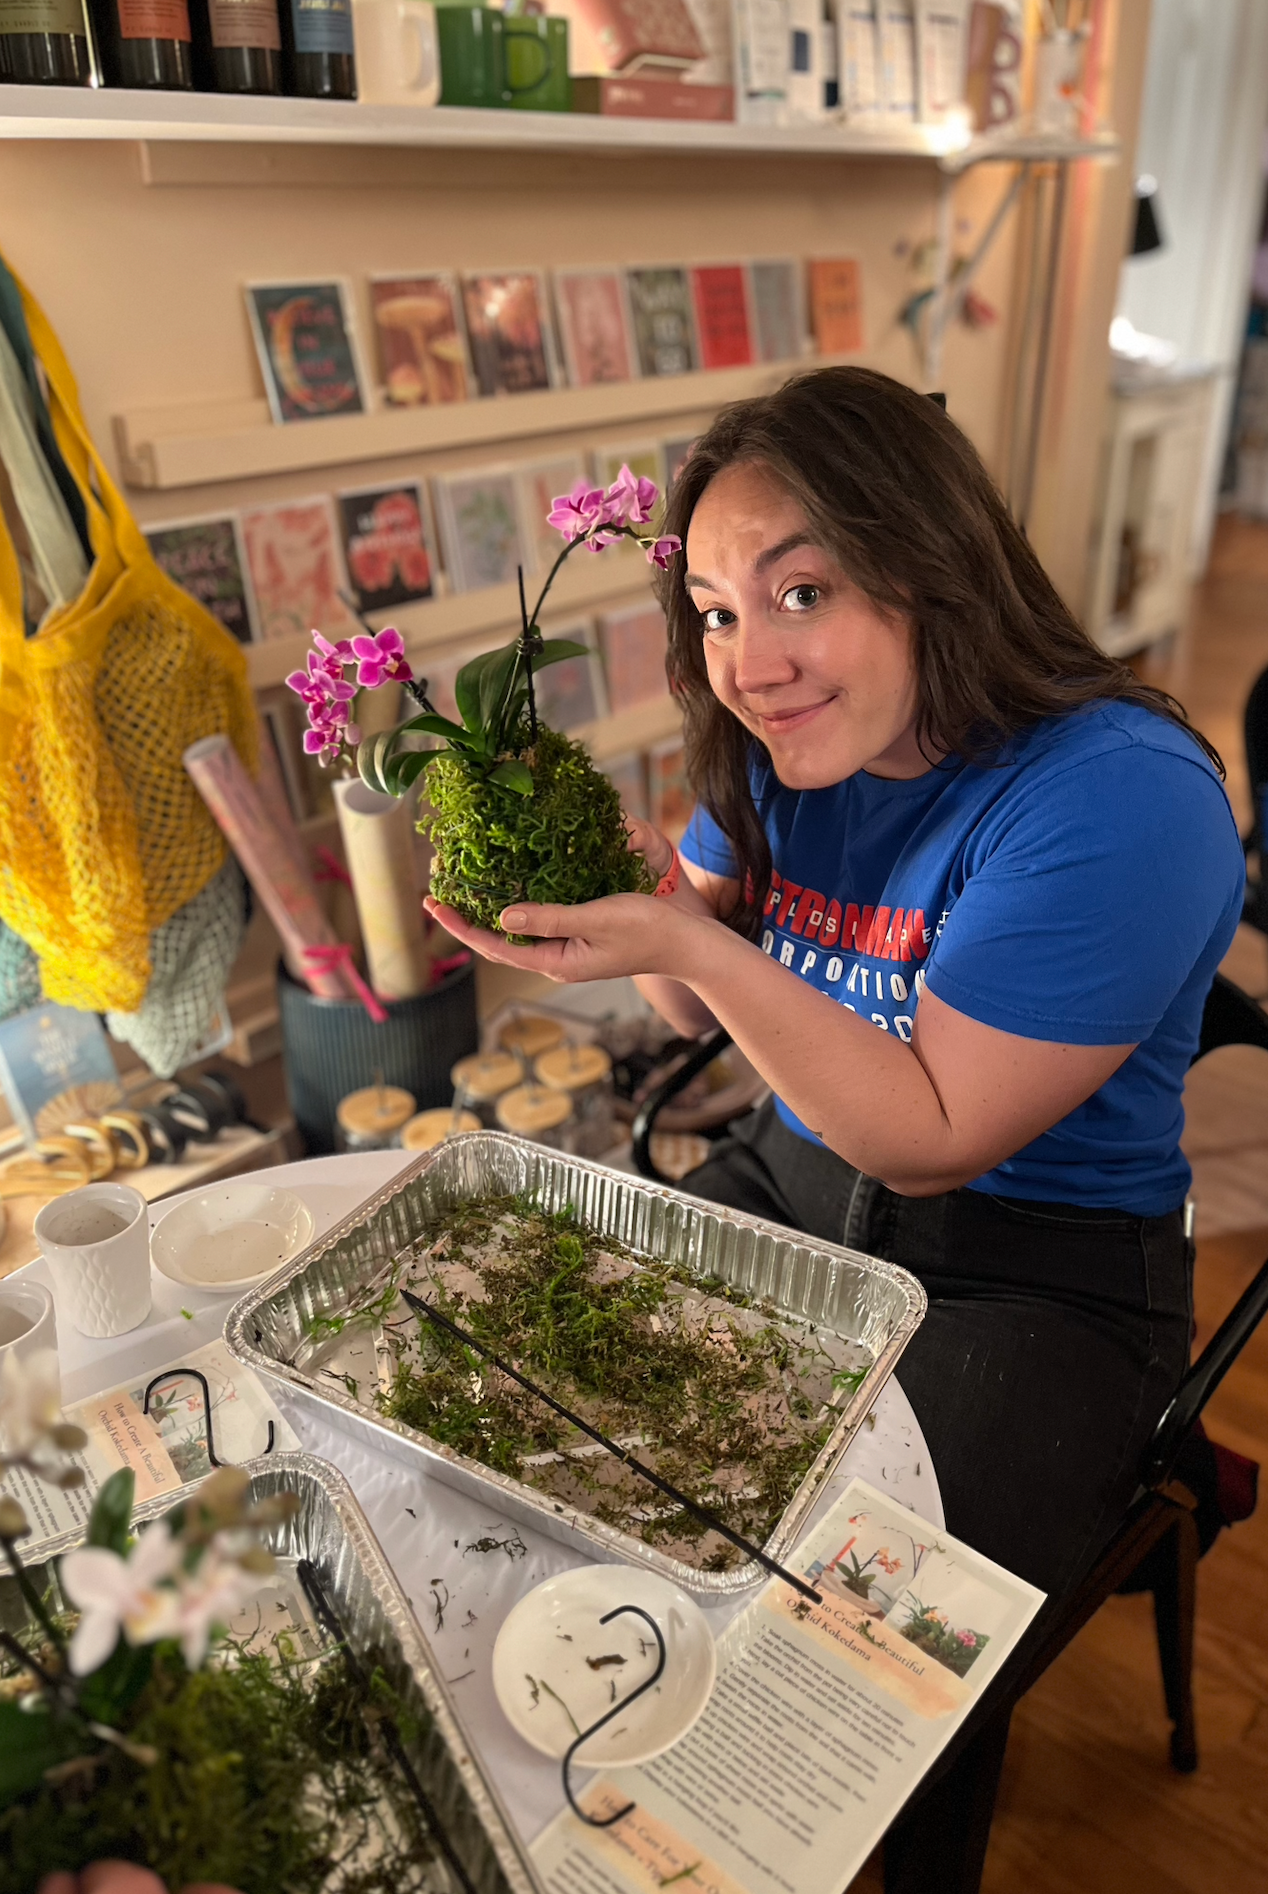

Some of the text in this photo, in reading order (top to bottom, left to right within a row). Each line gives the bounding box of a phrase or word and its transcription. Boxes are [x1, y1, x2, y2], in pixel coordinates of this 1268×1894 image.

[97, 1407, 131, 1465] Orchid Kokedama
[114, 1402, 126, 1418] How
[122, 1418, 130, 1426] to
[126, 1425, 142, 1447] Create
[142, 1453, 166, 1484] Beautiful
[787, 1599, 871, 1661] Ohid Kokedama
[821, 1603, 832, 1613] to
[834, 1611, 868, 1637] Create
[876, 1640, 925, 1676] Beautiful
[721, 1679, 737, 1693] Swish
[737, 1692, 747, 1700] the
[747, 1699, 761, 1711] roots
[729, 1673, 747, 1688] Gently
[746, 1687, 771, 1706] separate
[770, 1704, 780, 1713] the
[780, 1711, 795, 1724] roots
[795, 1721, 808, 1734] from
[808, 1732, 818, 1740] the
[818, 1740, 830, 1749] soil
[829, 1747, 841, 1758] that
[753, 1642, 763, 1651] the
[762, 1648, 782, 1666] blooms.
[783, 1663, 794, 1673] Dip
[800, 1676, 816, 1689] water
[815, 1687, 828, 1697] and
[827, 1695, 837, 1704] set
[836, 1702, 852, 1715] aside
[852, 1713, 861, 1721] for
[861, 1720, 872, 1729] ten
[761, 1635, 774, 1647] Take
[774, 1645, 783, 1653] the
[783, 1652, 801, 1665] orchid
[800, 1663, 813, 1675] from
[813, 1673, 823, 1681] the
[821, 1680, 833, 1689] pot
[832, 1686, 849, 1701] being
[849, 1698, 861, 1709] very
[861, 1708, 882, 1724] careful
[881, 1722, 892, 1731] not
[898, 1733, 916, 1748] touch
[761, 1660, 771, 1668] lay
[775, 1670, 785, 1678] cut
[783, 1676, 799, 1689] piece
[806, 1693, 828, 1709] chicken
[827, 1708, 840, 1718] wire
[848, 1723, 859, 1732] the
[859, 1730, 874, 1743] table
[880, 1745, 894, 1757] front
[768, 1629, 782, 1640] Soak
[782, 1639, 810, 1660] sphagnum
[809, 1659, 825, 1671] moss
[831, 1674, 847, 1686] water
[847, 1684, 855, 1692] for
[855, 1691, 872, 1705] about
[872, 1702, 881, 1711] 20
[881, 1709, 904, 1726] minutes
[715, 1687, 728, 1699] Take
[732, 1702, 748, 1714] small
[762, 1724, 774, 1734] ball
[773, 1732, 785, 1742] and
[784, 1741, 801, 1754] place
[721, 1706, 735, 1718] roots
[735, 1717, 755, 1733] around
[766, 1739, 779, 1751] help
[750, 1676, 760, 1685] the
[760, 1684, 781, 1700] chicken
[781, 1699, 793, 1710] wire
[793, 1709, 805, 1719] with
[810, 1720, 824, 1732] layer
[832, 1736, 862, 1760] sphagnum
[637, 1826, 661, 1850] Care
[660, 1846, 680, 1866] For
